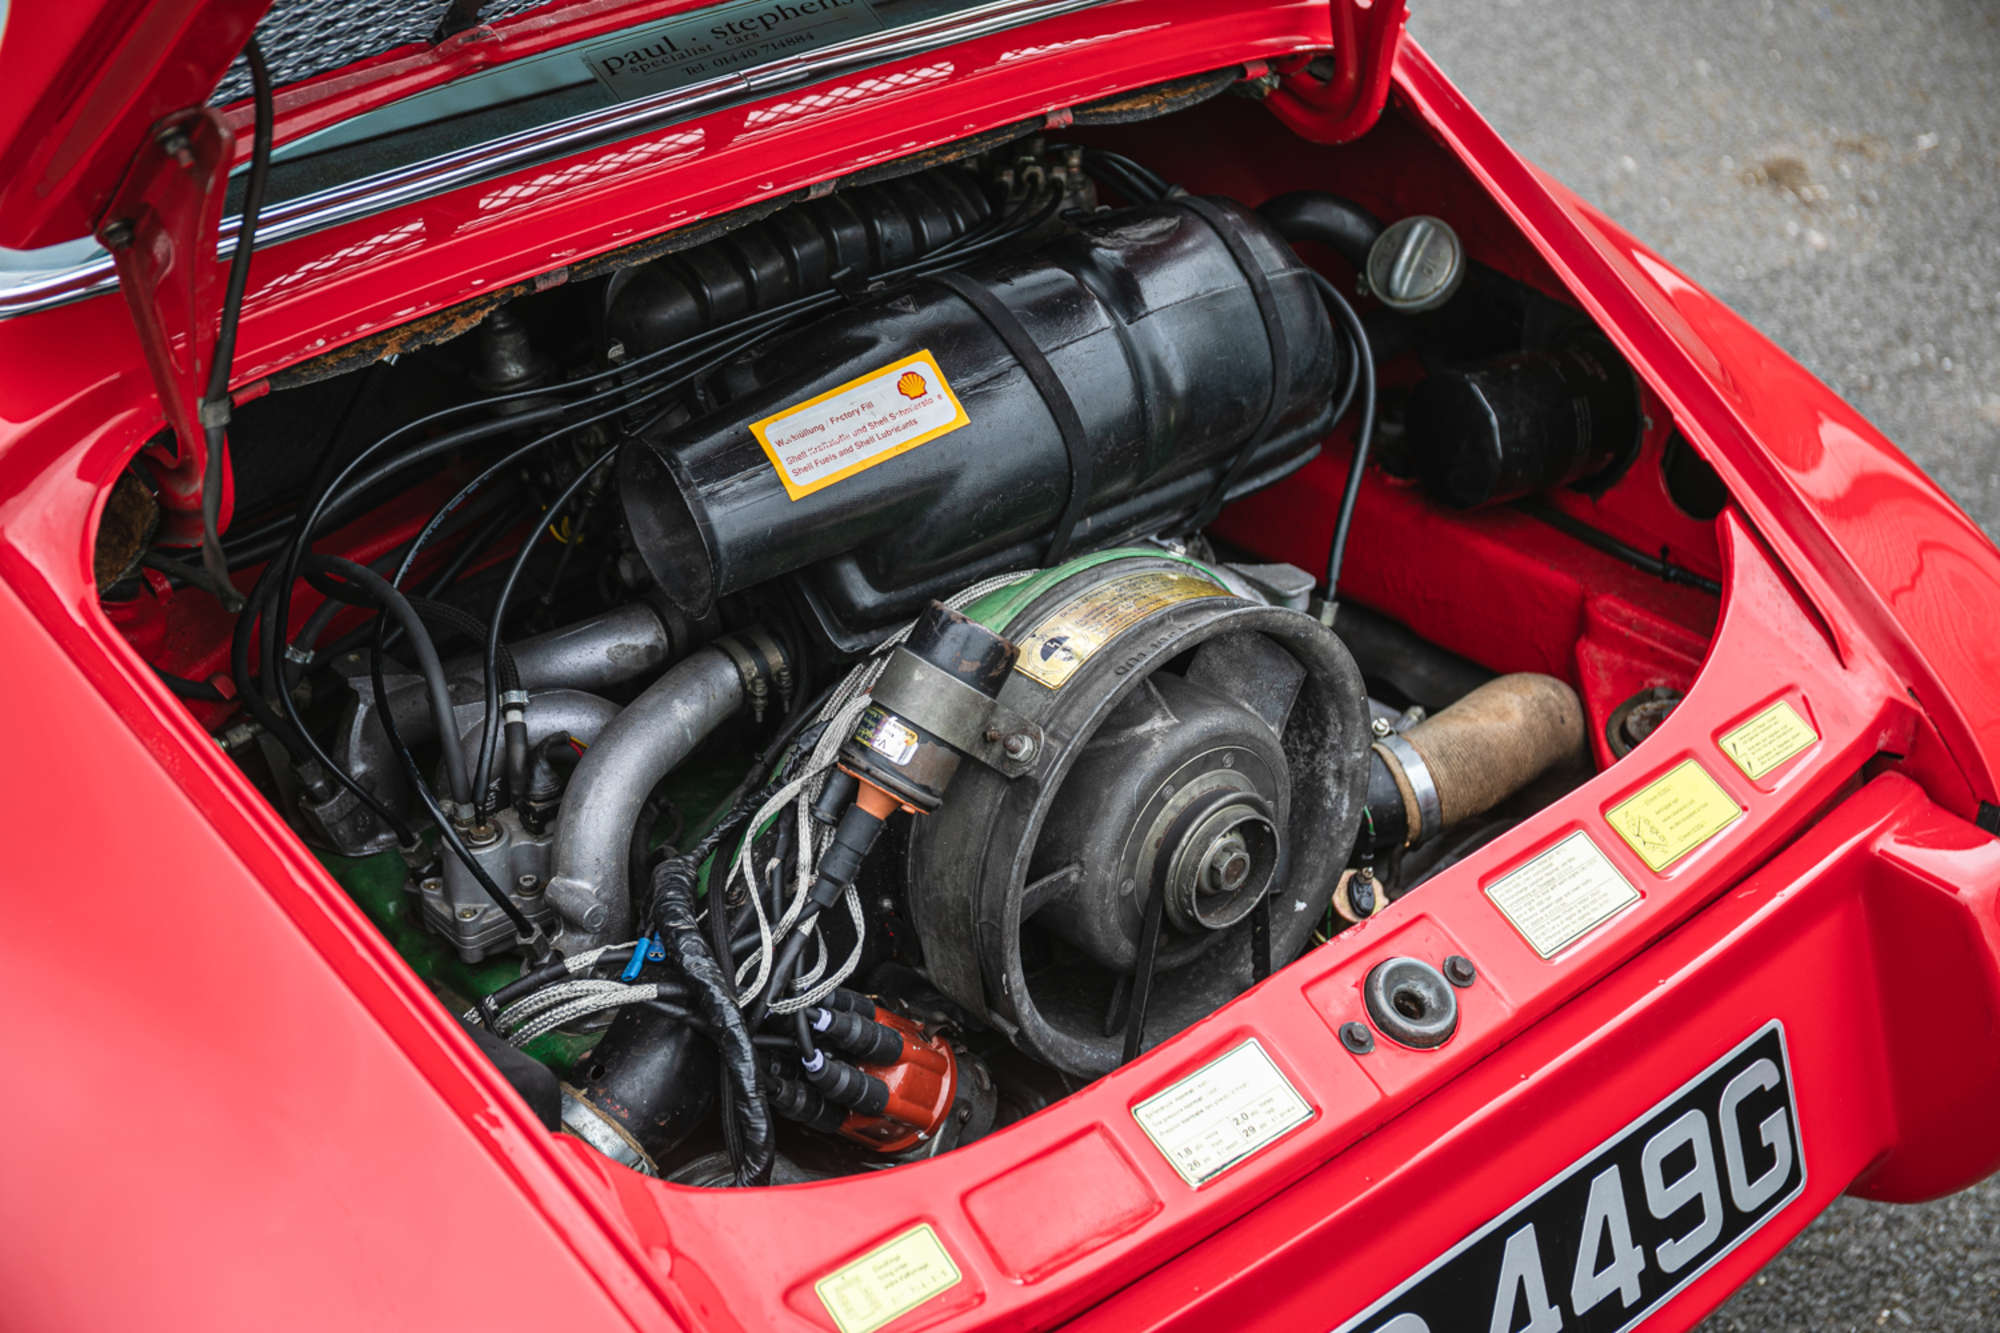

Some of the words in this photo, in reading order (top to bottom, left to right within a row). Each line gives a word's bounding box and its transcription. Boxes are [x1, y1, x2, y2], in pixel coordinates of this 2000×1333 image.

[602, 35, 679, 76] paul
[629, 44, 713, 73] specialist
[725, 32, 760, 46] cars
[712, 48, 758, 68] 01440
[760, 32, 815, 51] 714884
[851, 424, 868, 437] und
[867, 415, 888, 429] Shell
[791, 463, 814, 477] Shell
[813, 452, 838, 467] Fuels
[838, 443, 854, 457] and
[853, 435, 876, 450] Shell
[874, 418, 919, 440] Lubricants
[1489, 1058, 1792, 1333] 449G
